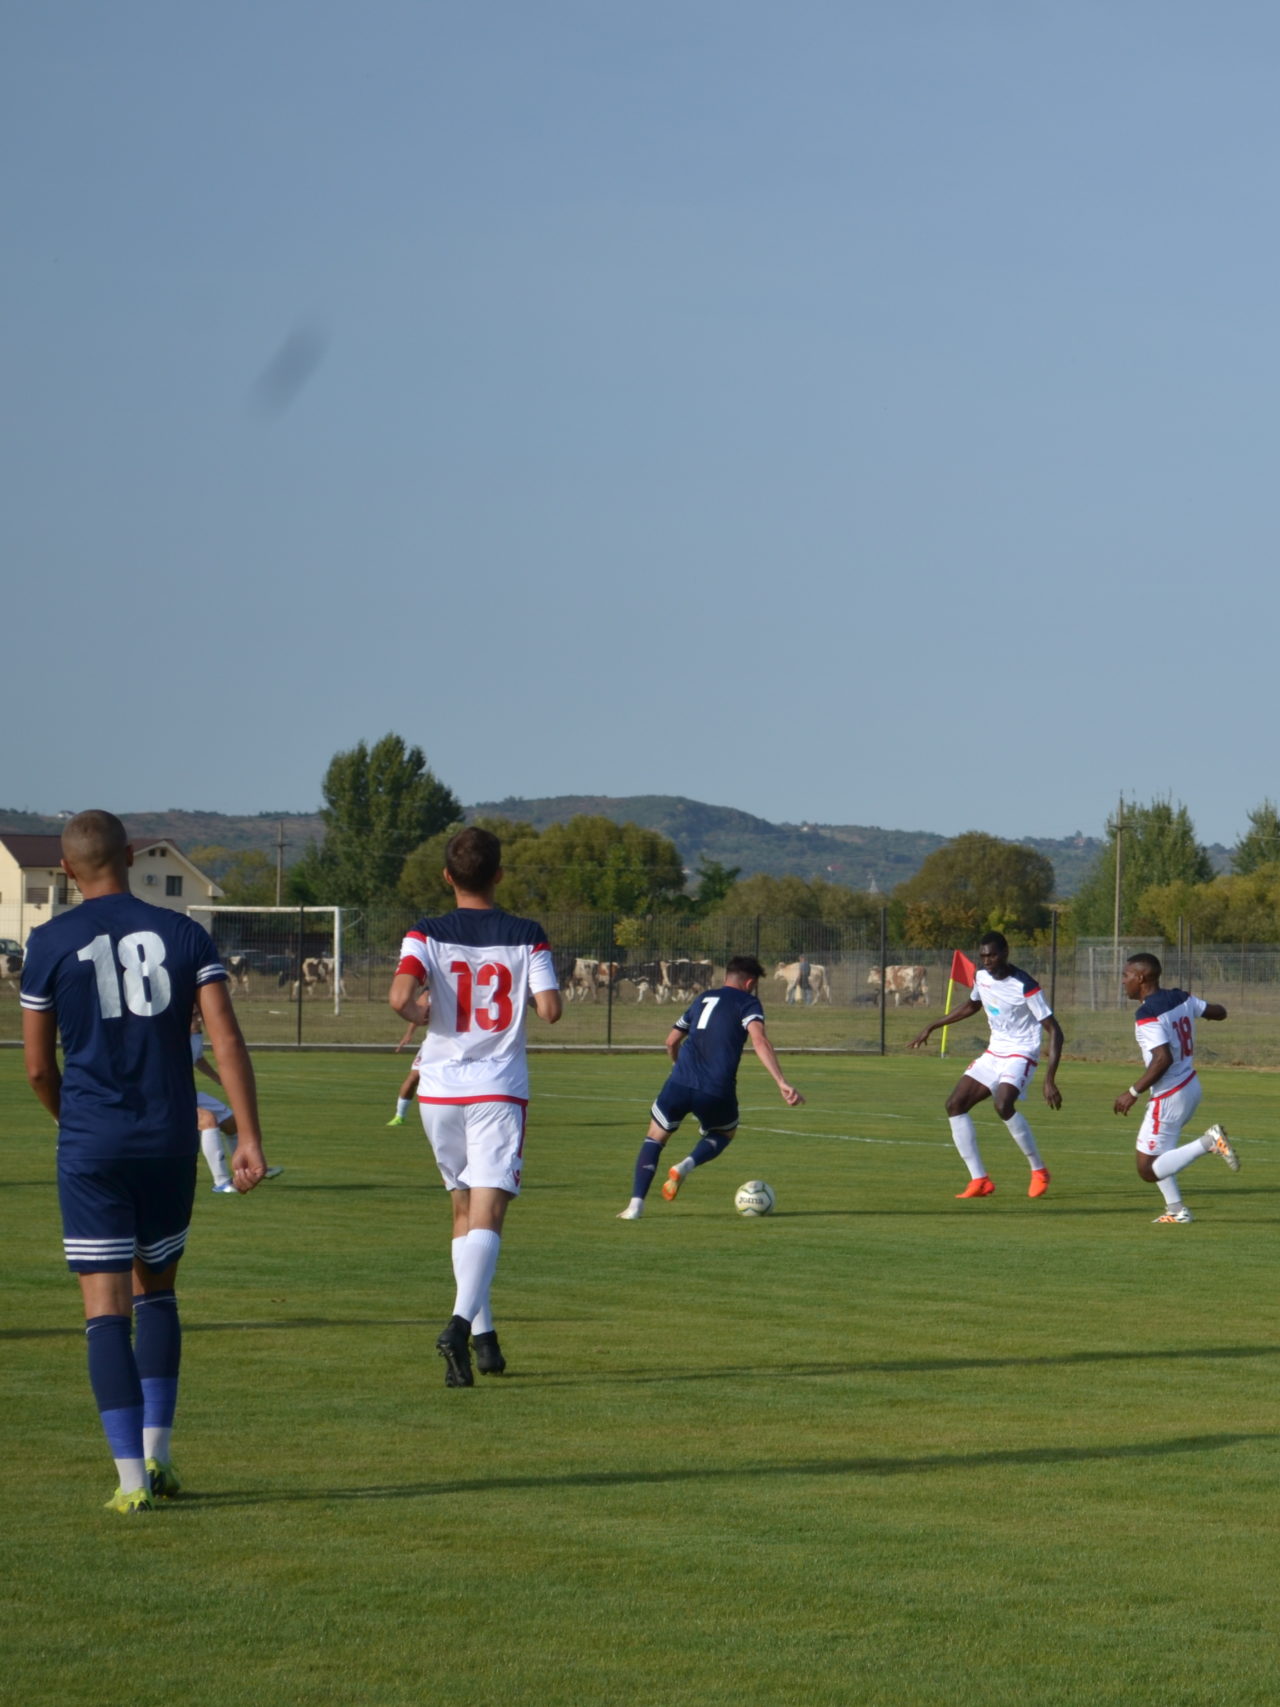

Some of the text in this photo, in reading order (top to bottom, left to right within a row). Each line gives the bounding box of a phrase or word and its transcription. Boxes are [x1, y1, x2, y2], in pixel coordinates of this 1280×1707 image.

[76, 931, 171, 1019] 18
[450, 960, 513, 1033] 13
[1172, 1015, 1194, 1061] 18
